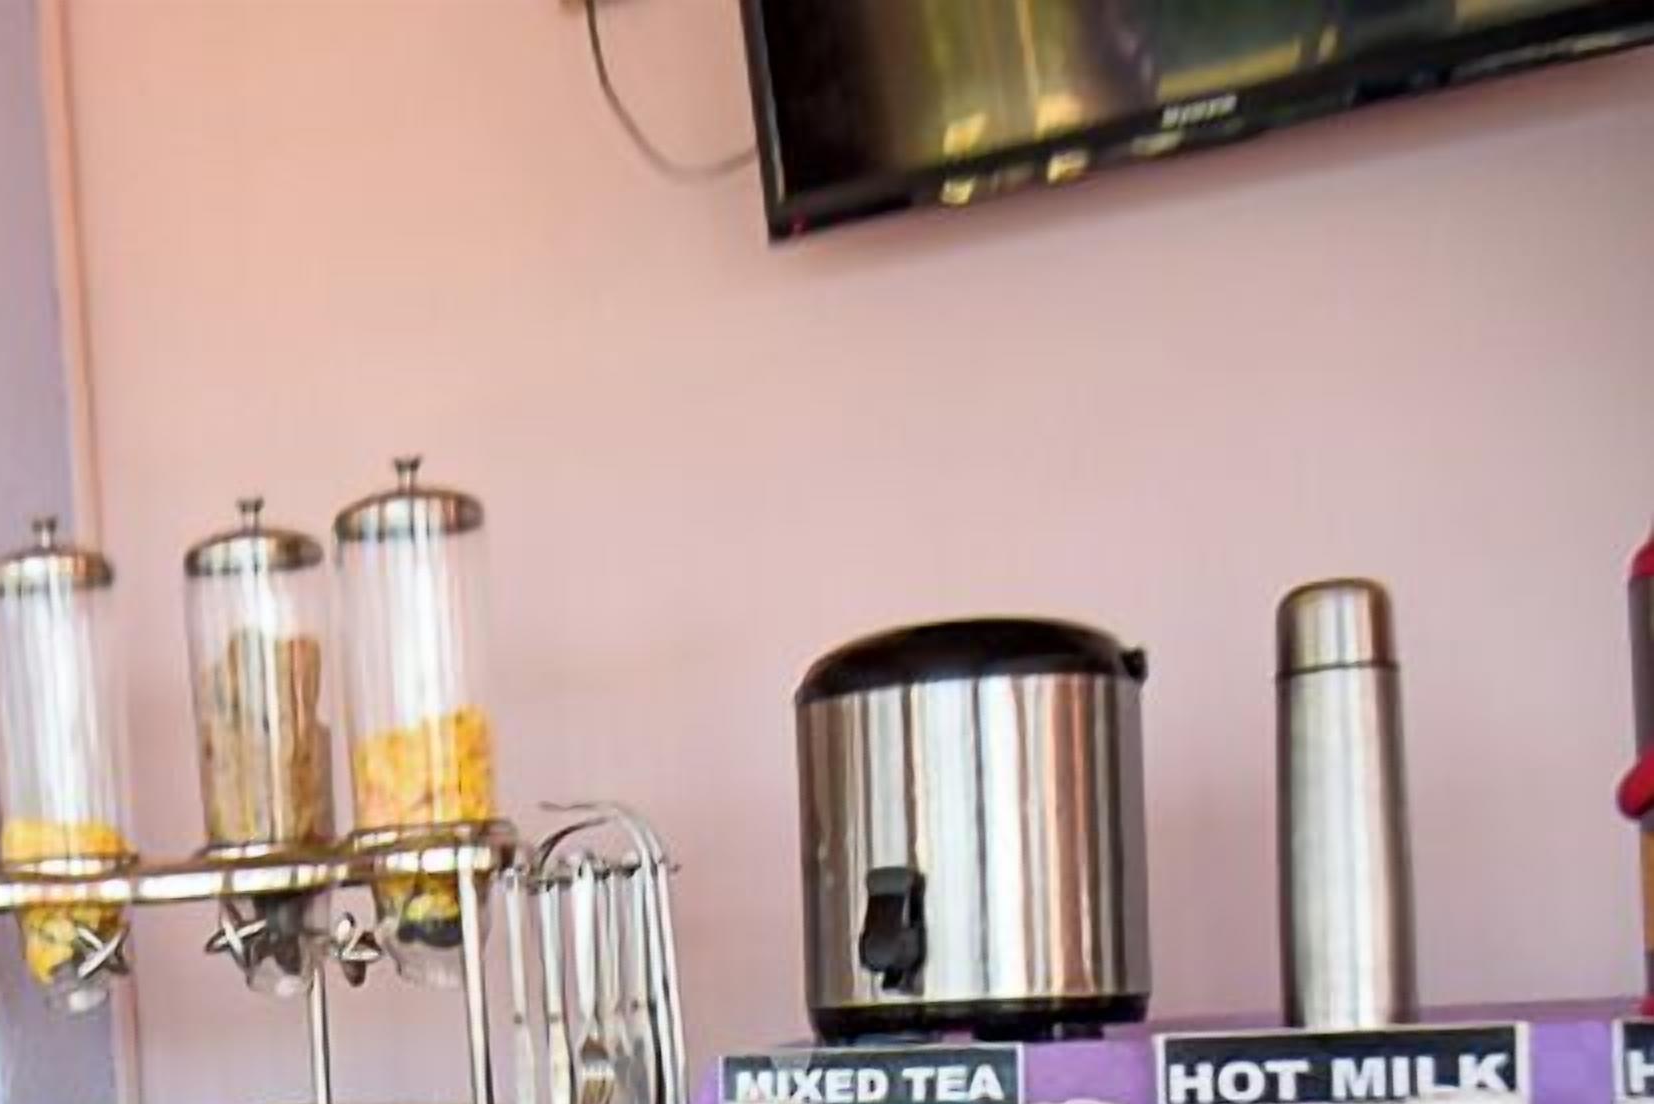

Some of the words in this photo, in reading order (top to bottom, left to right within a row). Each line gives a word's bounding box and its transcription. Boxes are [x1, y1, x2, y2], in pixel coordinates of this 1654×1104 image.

[735, 1067, 889, 1104] MIXED
[902, 1063, 1006, 1102] TEA
[1169, 1059, 1310, 1104] HOT
[1331, 1052, 1508, 1099] MILK
